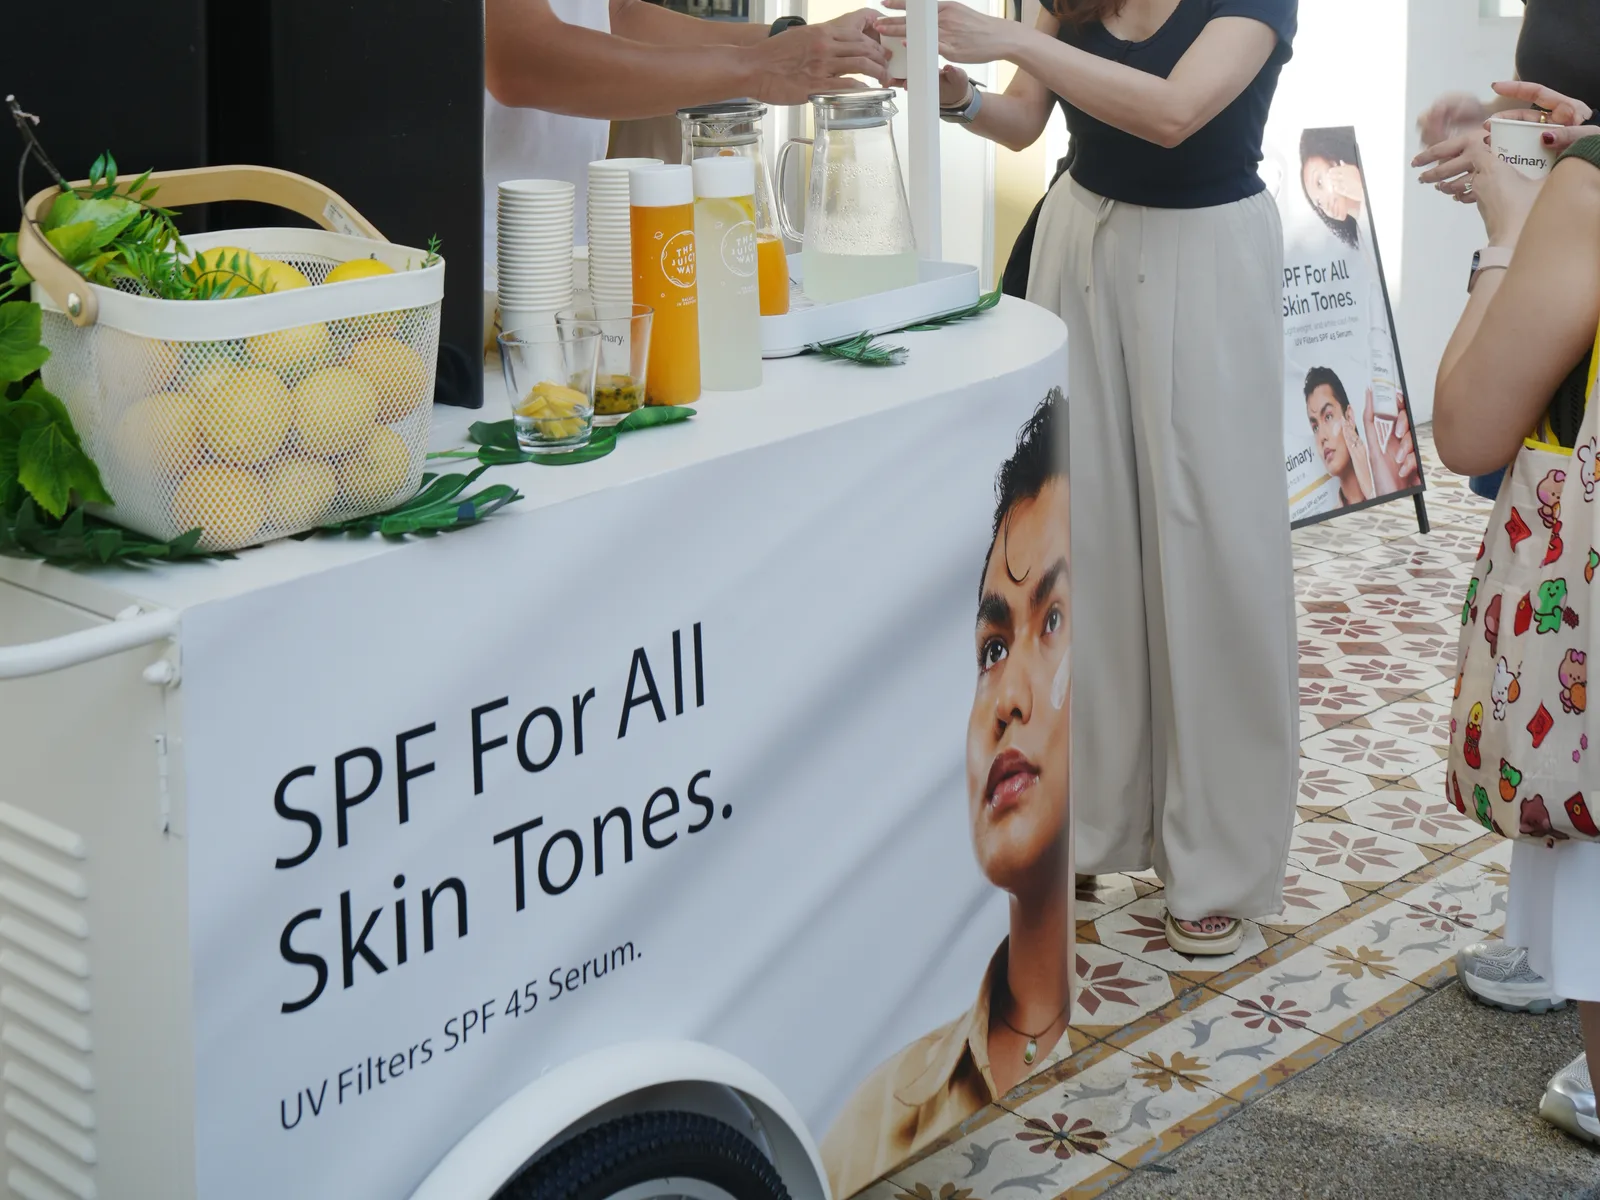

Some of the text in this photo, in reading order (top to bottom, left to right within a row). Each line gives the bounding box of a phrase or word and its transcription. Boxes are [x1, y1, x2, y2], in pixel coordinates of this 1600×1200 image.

[676, 243, 693, 258] THE
[676, 263, 695, 274] WAY
[1282, 259, 1349, 288] PF For All
[1311, 291, 1357, 313] Tones.
[273, 622, 705, 869] SPF For All
[279, 769, 733, 1014] Skin Tones.
[280, 940, 642, 1130] UV Filters SPF 45 Serum.
